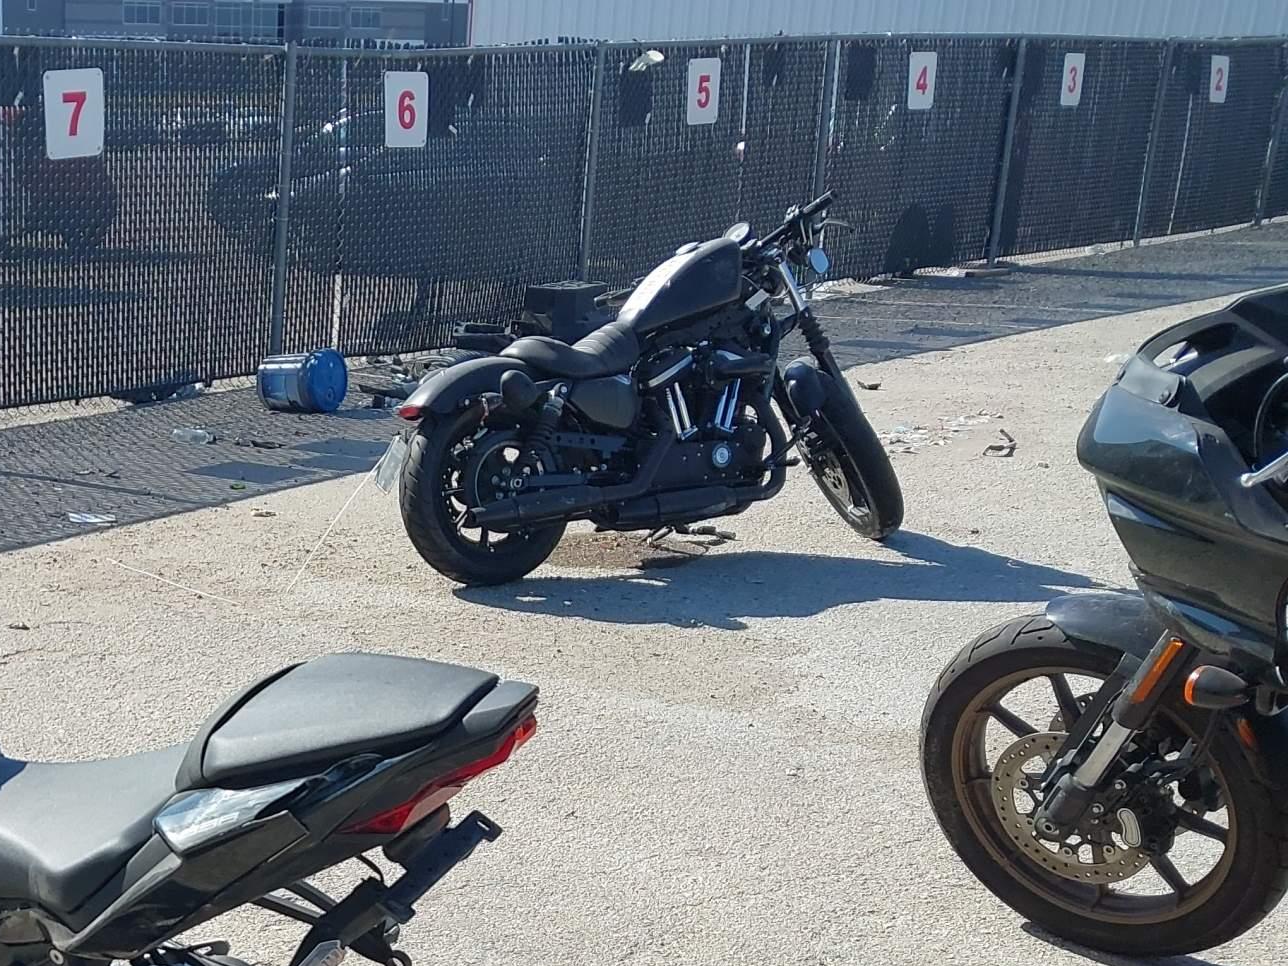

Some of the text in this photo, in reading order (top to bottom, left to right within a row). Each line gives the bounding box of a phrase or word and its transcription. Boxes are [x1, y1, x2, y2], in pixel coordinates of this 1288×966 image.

[697, 75, 711, 109] 5
[916, 65, 928, 95] 4
[1067, 66, 1078, 94] 3
[1215, 67, 1224, 92] 2
[62, 91, 87, 136] 7
[398, 90, 416, 130] 6
